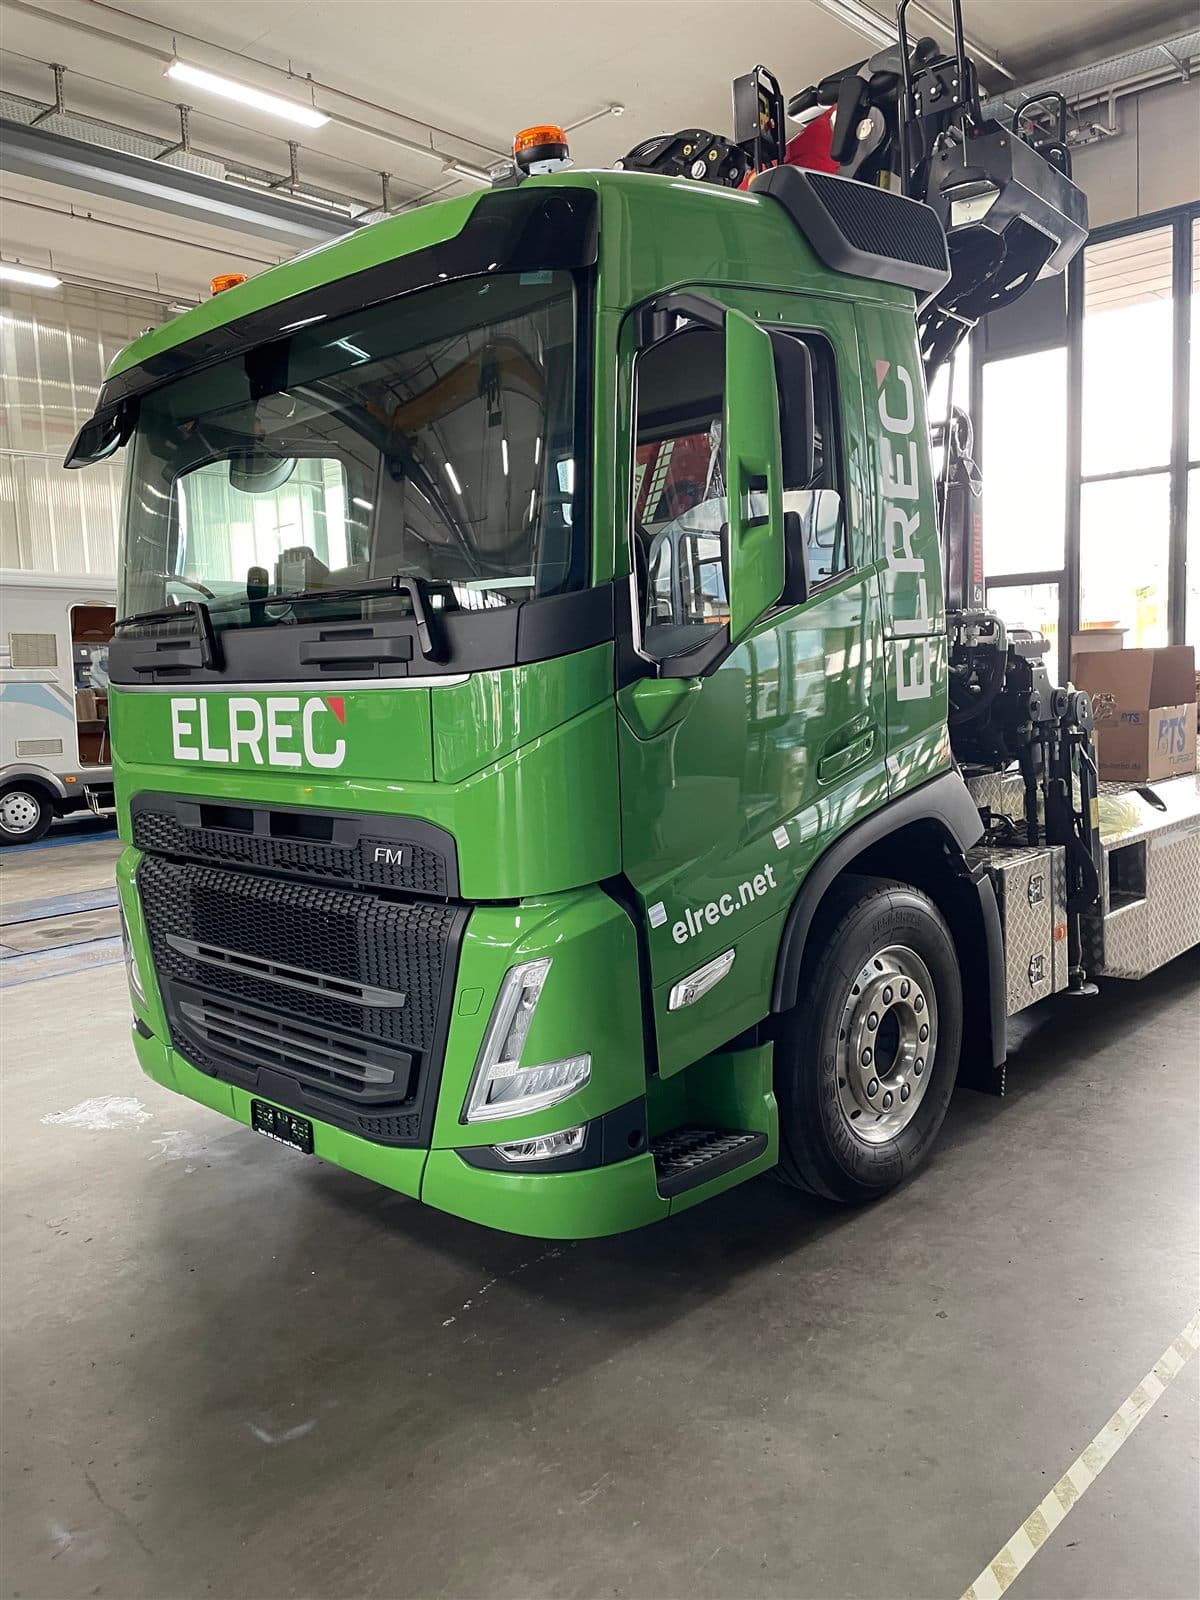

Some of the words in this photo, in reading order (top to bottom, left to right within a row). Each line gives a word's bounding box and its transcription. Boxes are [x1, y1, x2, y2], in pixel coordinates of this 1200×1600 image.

[876, 361, 931, 701] ELREC
[170, 697, 346, 768] ELREC
[374, 848, 403, 865] FM
[672, 864, 777, 944] elrec.net
